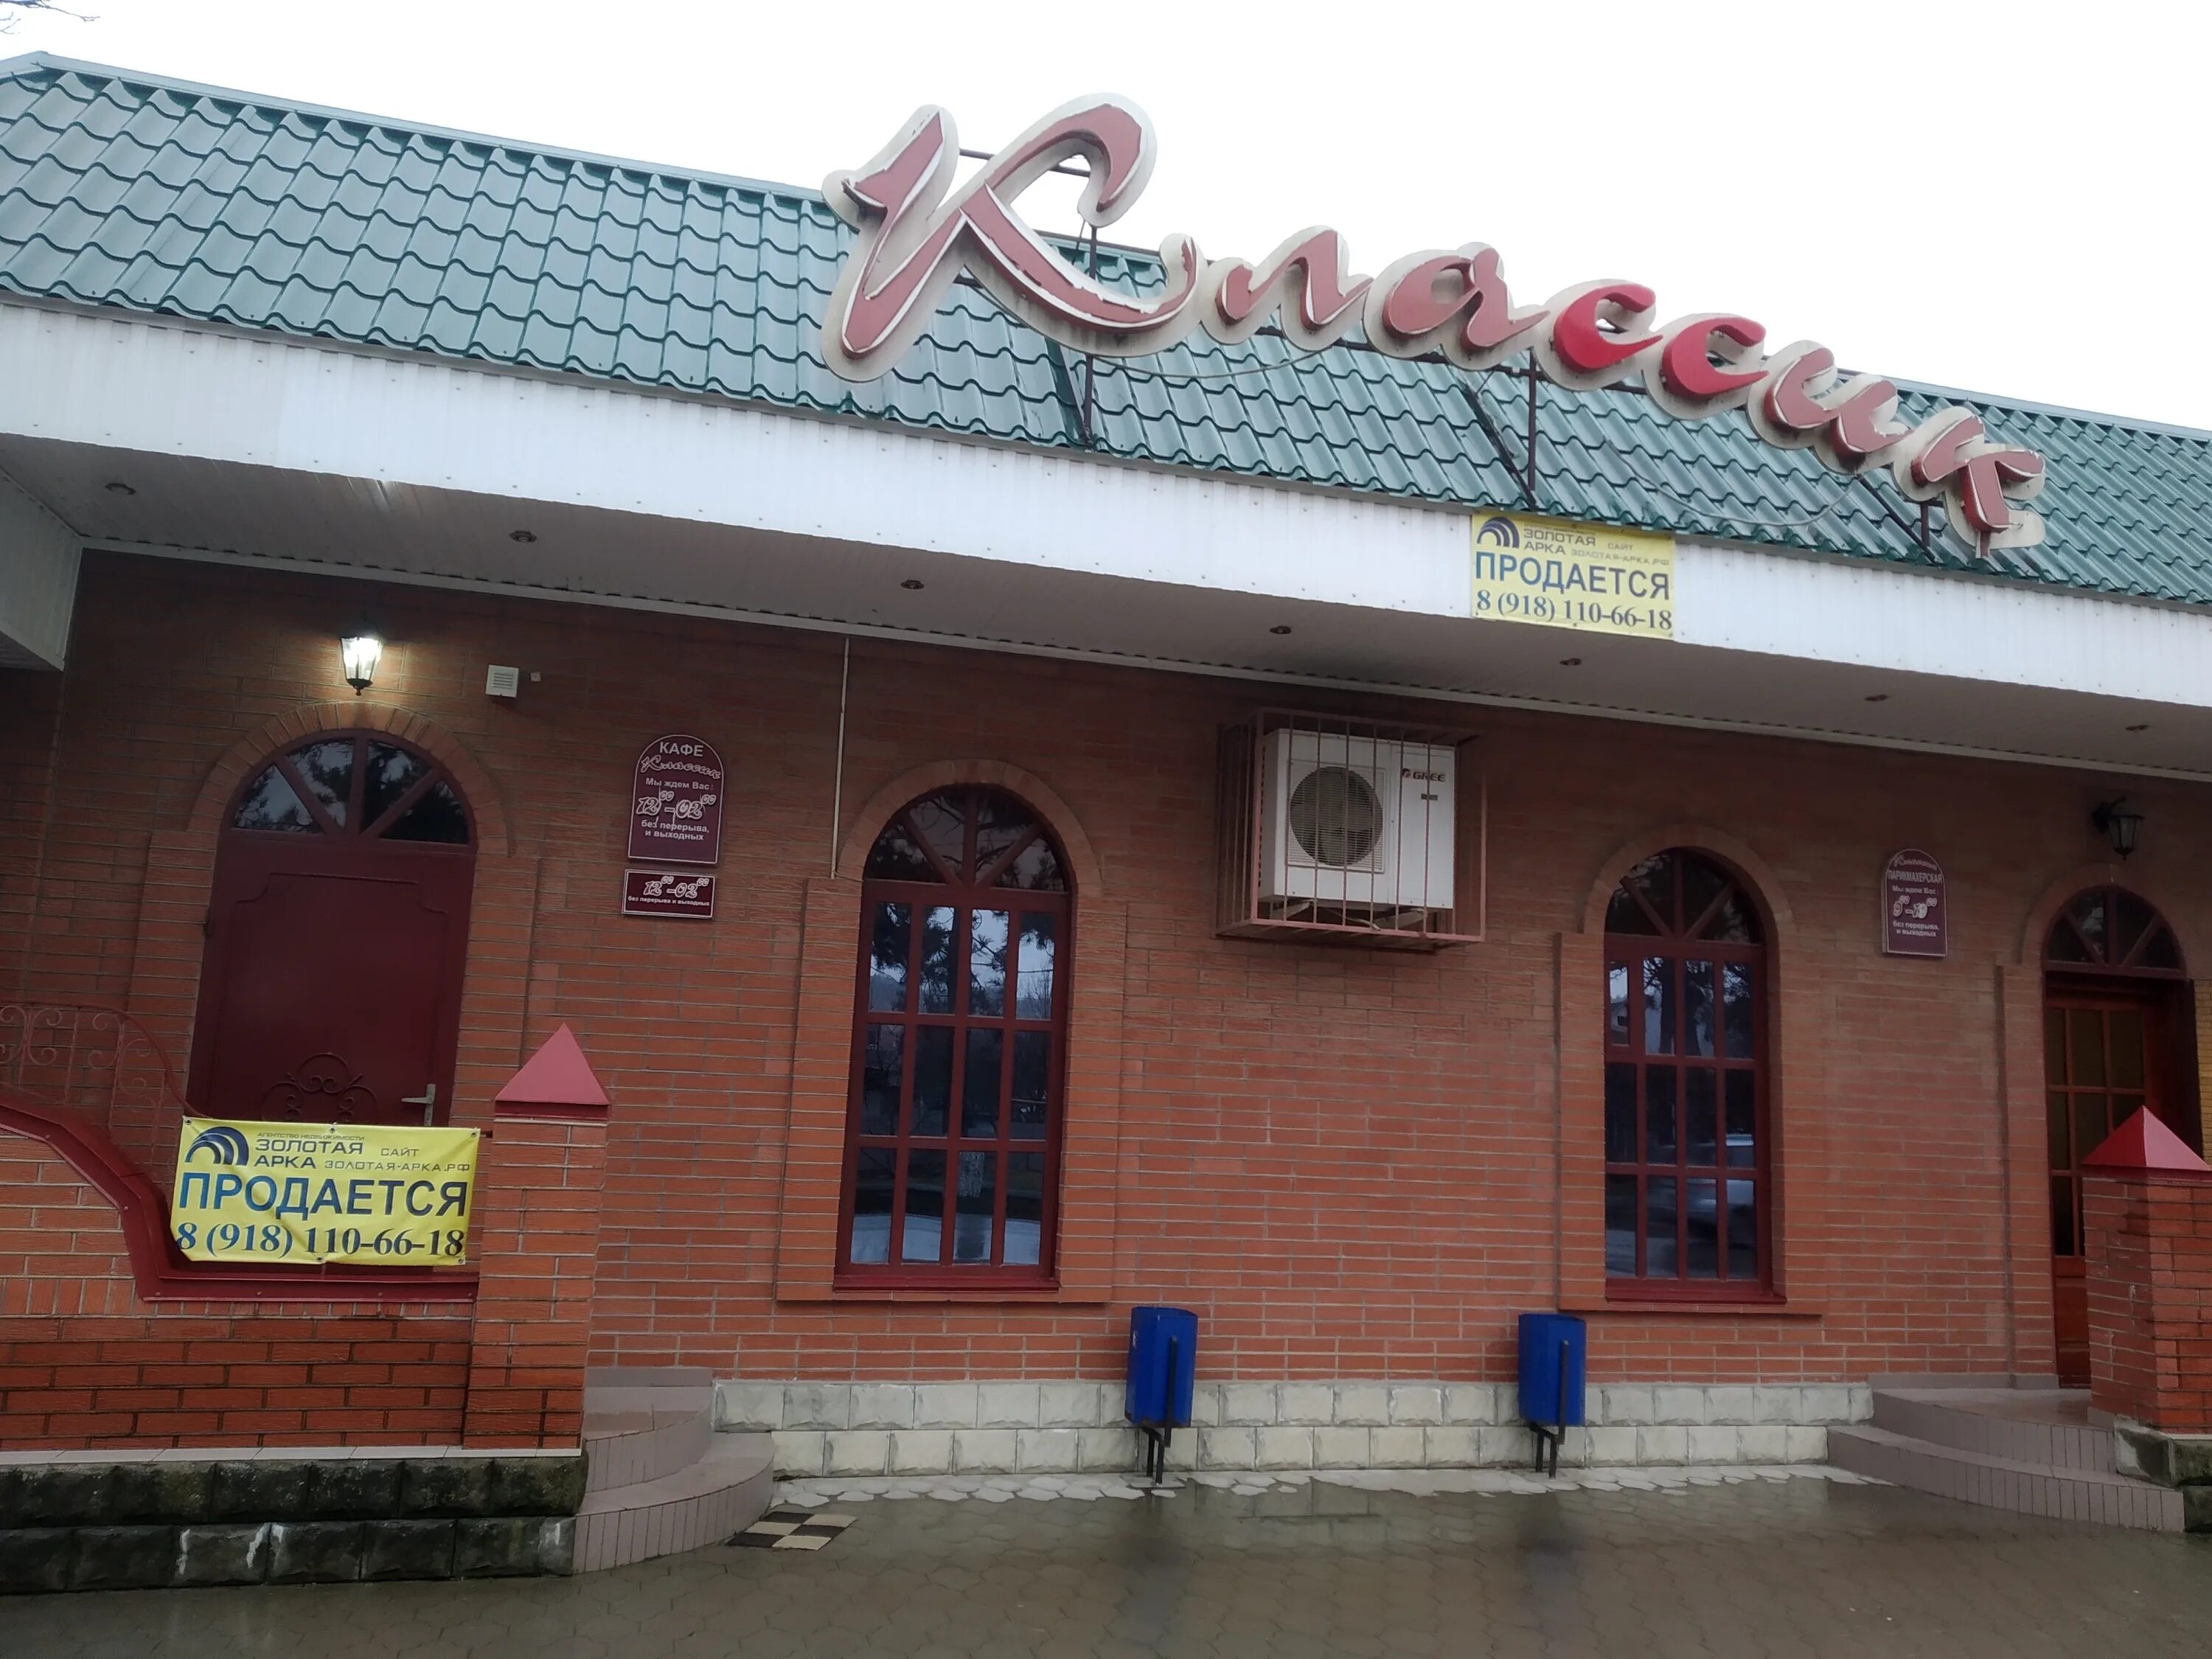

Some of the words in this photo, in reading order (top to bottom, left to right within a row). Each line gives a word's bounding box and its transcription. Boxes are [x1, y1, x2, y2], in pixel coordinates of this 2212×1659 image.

[830, 97, 2045, 542] Классик
[1523, 528, 1596, 546] ЗОЛОТАЯ
[1523, 540, 1566, 555] АРКА
[1607, 541, 1634, 552] САЙТ
[1571, 549, 1670, 566] ЗОЛОТАЯ-АРКА.РФ
[1475, 551, 1670, 600] ПРОДАЕТСЯ
[1477, 589, 1491, 611] 8
[1498, 592, 1556, 622] (918)
[1564, 599, 1673, 630] 110-66-18
[659, 741, 704, 757] КАФЕ
[645, 777, 662, 786] Мы
[664, 780, 689, 789] ждем
[641, 819, 658, 828] без
[660, 822, 710, 834] перерыва,
[653, 830, 704, 841] выходных
[1888, 869, 1943, 884] ПАРИКМАХЕРСКАЯ
[255, 1138, 364, 1155] ЗОЛОТАЯ
[380, 1147, 420, 1158] САЙТ
[254, 1155, 317, 1169] АРКА
[324, 1160, 470, 1172] ЗОЛОТАЯ-АРКА.РФ
[178, 1172, 468, 1221] ПРОДАЕТСЯ
[176, 1222, 198, 1251] 8
[206, 1222, 293, 1259] (918)
[305, 1226, 465, 1257] 110-66-18
